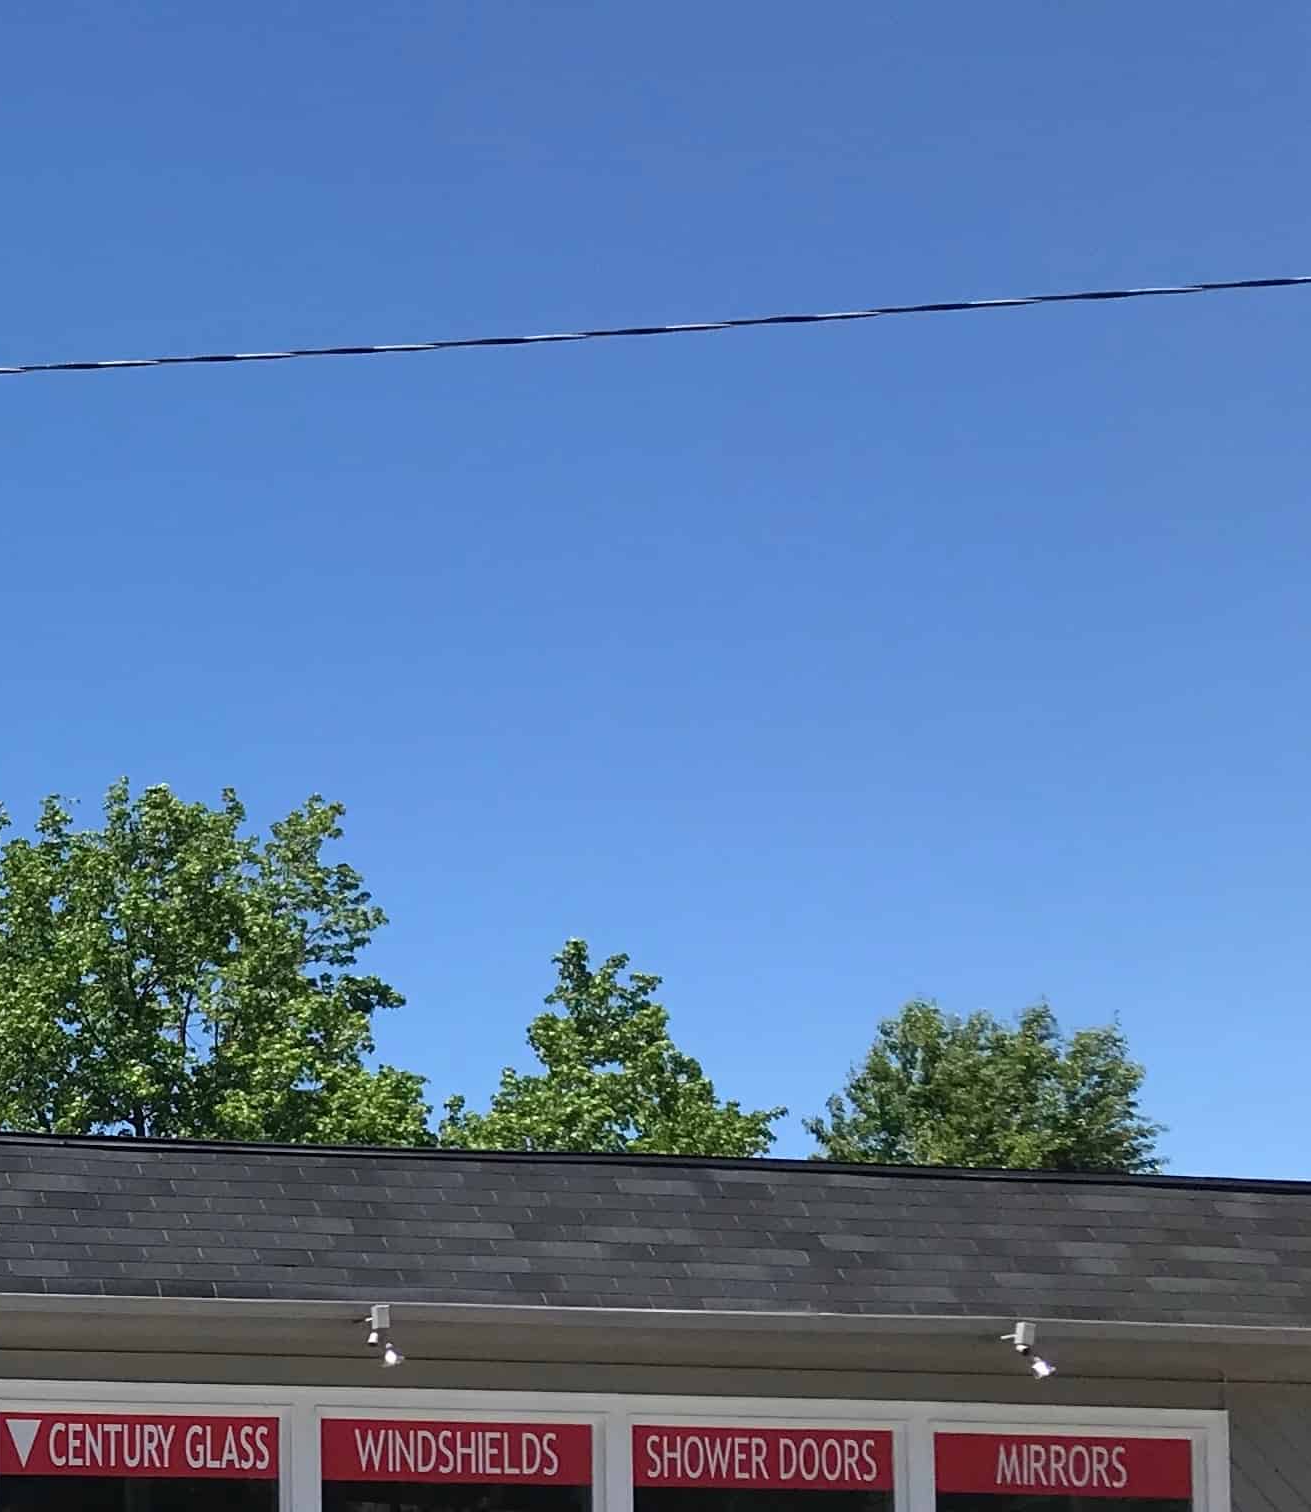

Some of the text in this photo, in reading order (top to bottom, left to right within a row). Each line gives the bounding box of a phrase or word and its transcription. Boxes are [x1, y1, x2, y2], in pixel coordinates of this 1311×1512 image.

[49, 1422, 270, 1470] CENTURY GLASS
[354, 1428, 558, 1476] WINDSHIELDS
[646, 1435, 877, 1482] SHOWER DOORS
[996, 1444, 1127, 1488] MIRRORS
